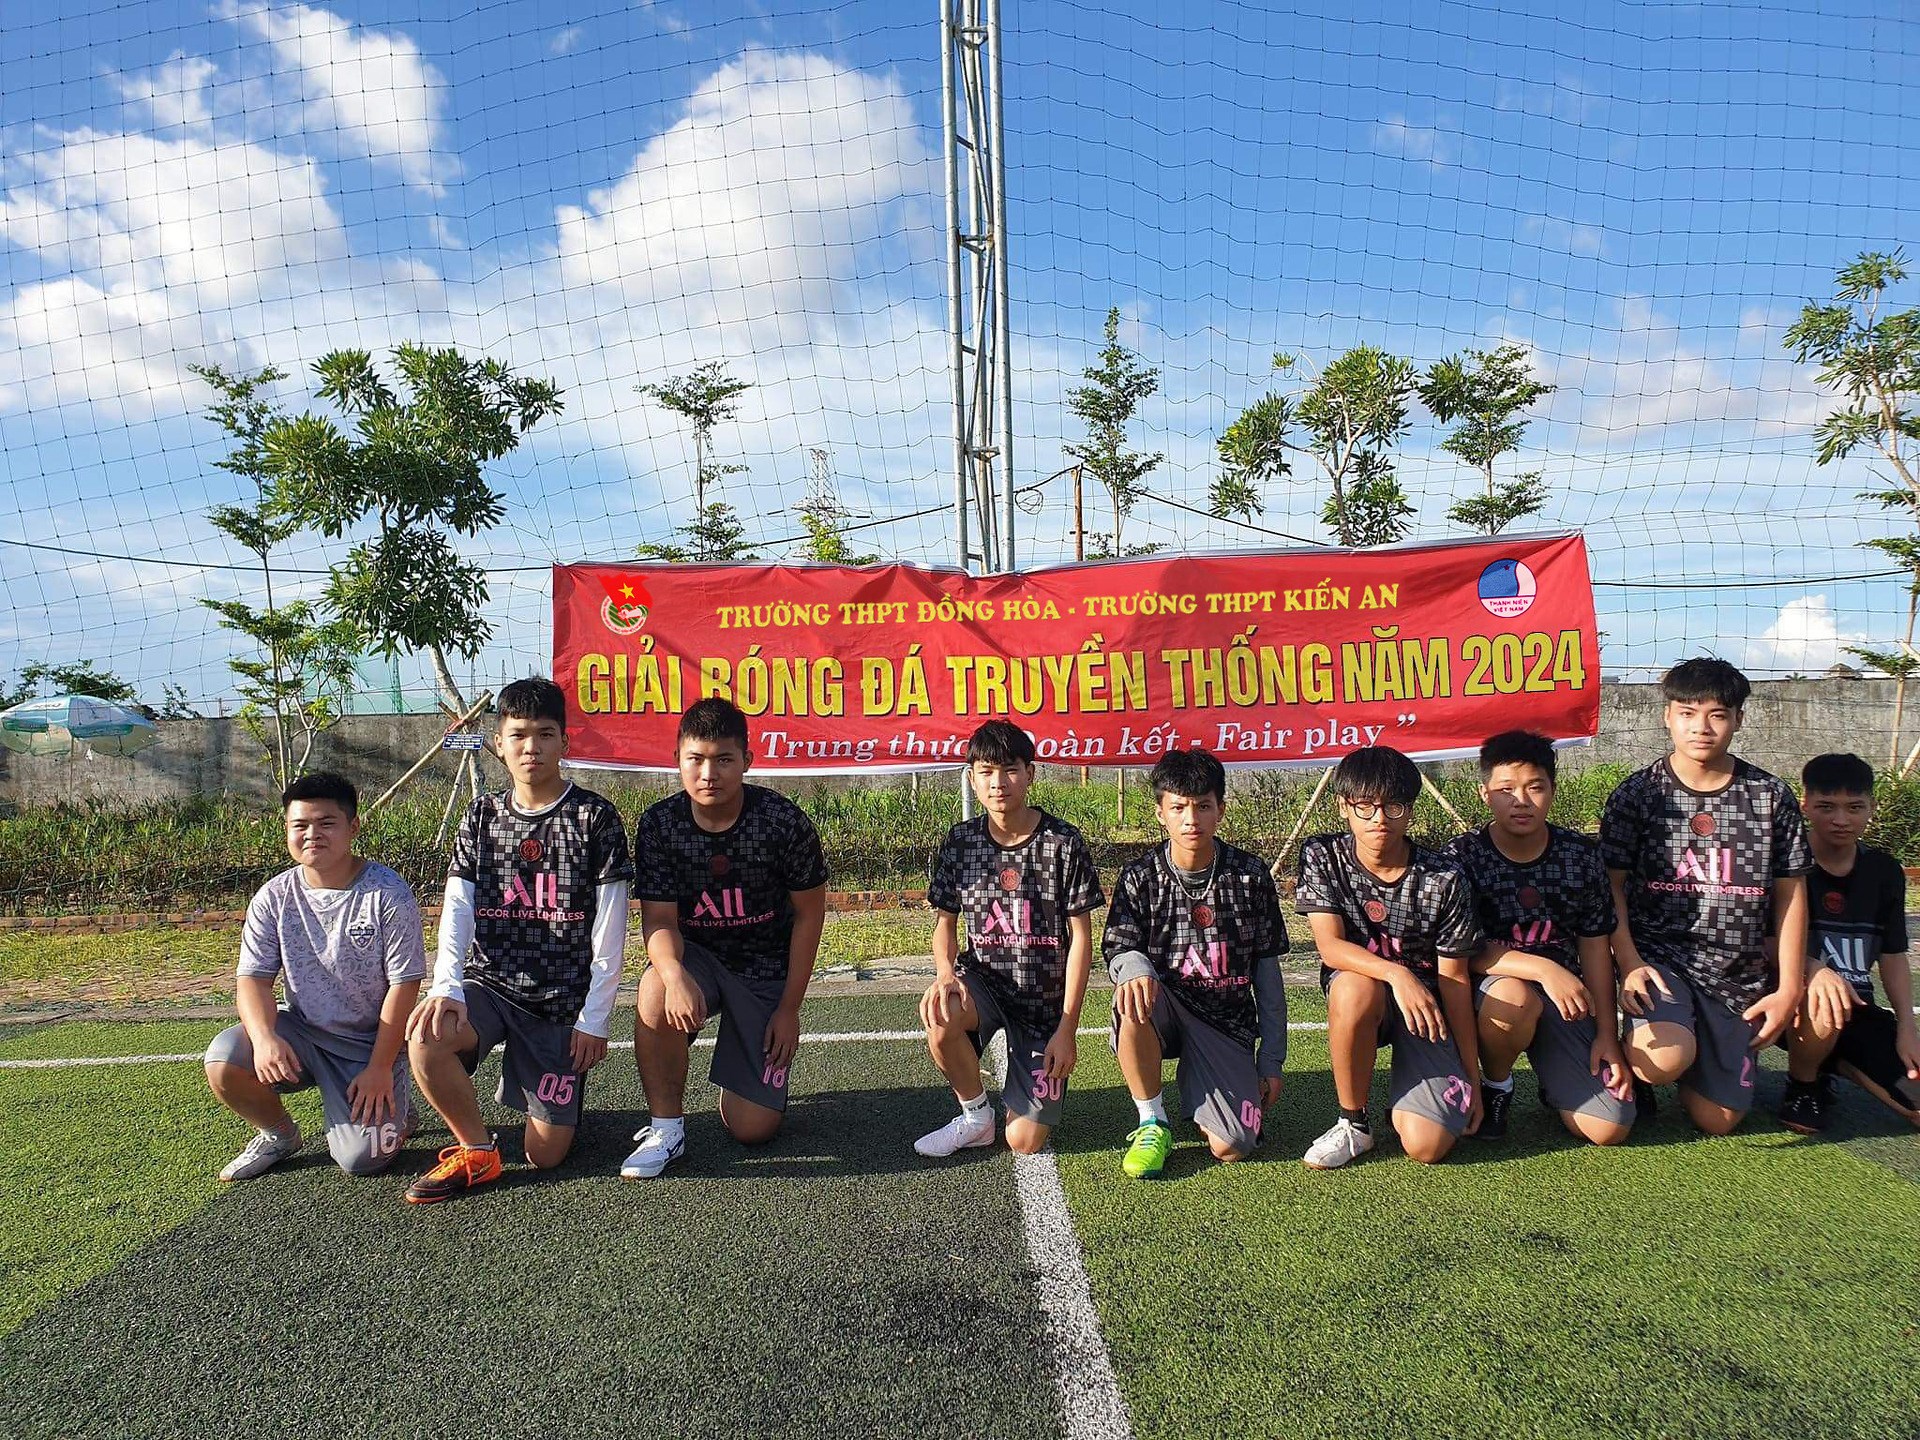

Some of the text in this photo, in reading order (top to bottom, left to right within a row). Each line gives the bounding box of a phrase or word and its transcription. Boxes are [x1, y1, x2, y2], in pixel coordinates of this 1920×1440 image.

[716, 600, 831, 629] TRƯỜNG
[838, 602, 909, 625] THPT
[917, 592, 995, 623] ĐỒNG
[1002, 595, 1061, 622] HÒA
[1082, 590, 1198, 617] TRƯỜNG
[1205, 591, 1276, 613] THPT
[1283, 577, 1351, 612] KIẾN
[1358, 583, 1400, 610] AN
[577, 624, 1587, 717] GIẢI BÓNG ĐÁ TRUYỀN THỐNG NĂM 2024
[760, 731, 879, 762] Trung
[1023, 729, 1105, 758] oàn
[1116, 722, 1181, 755] kết
[1212, 721, 1293, 751] Fair
[1302, 718, 1386, 755] play
[511, 909, 536, 919] LIVE
[536, 910, 586, 921] LIMITLESS
[537, 1072, 576, 1105] 05
[1241, 1100, 1262, 1135] 06
[367, 1123, 399, 1159] 16
